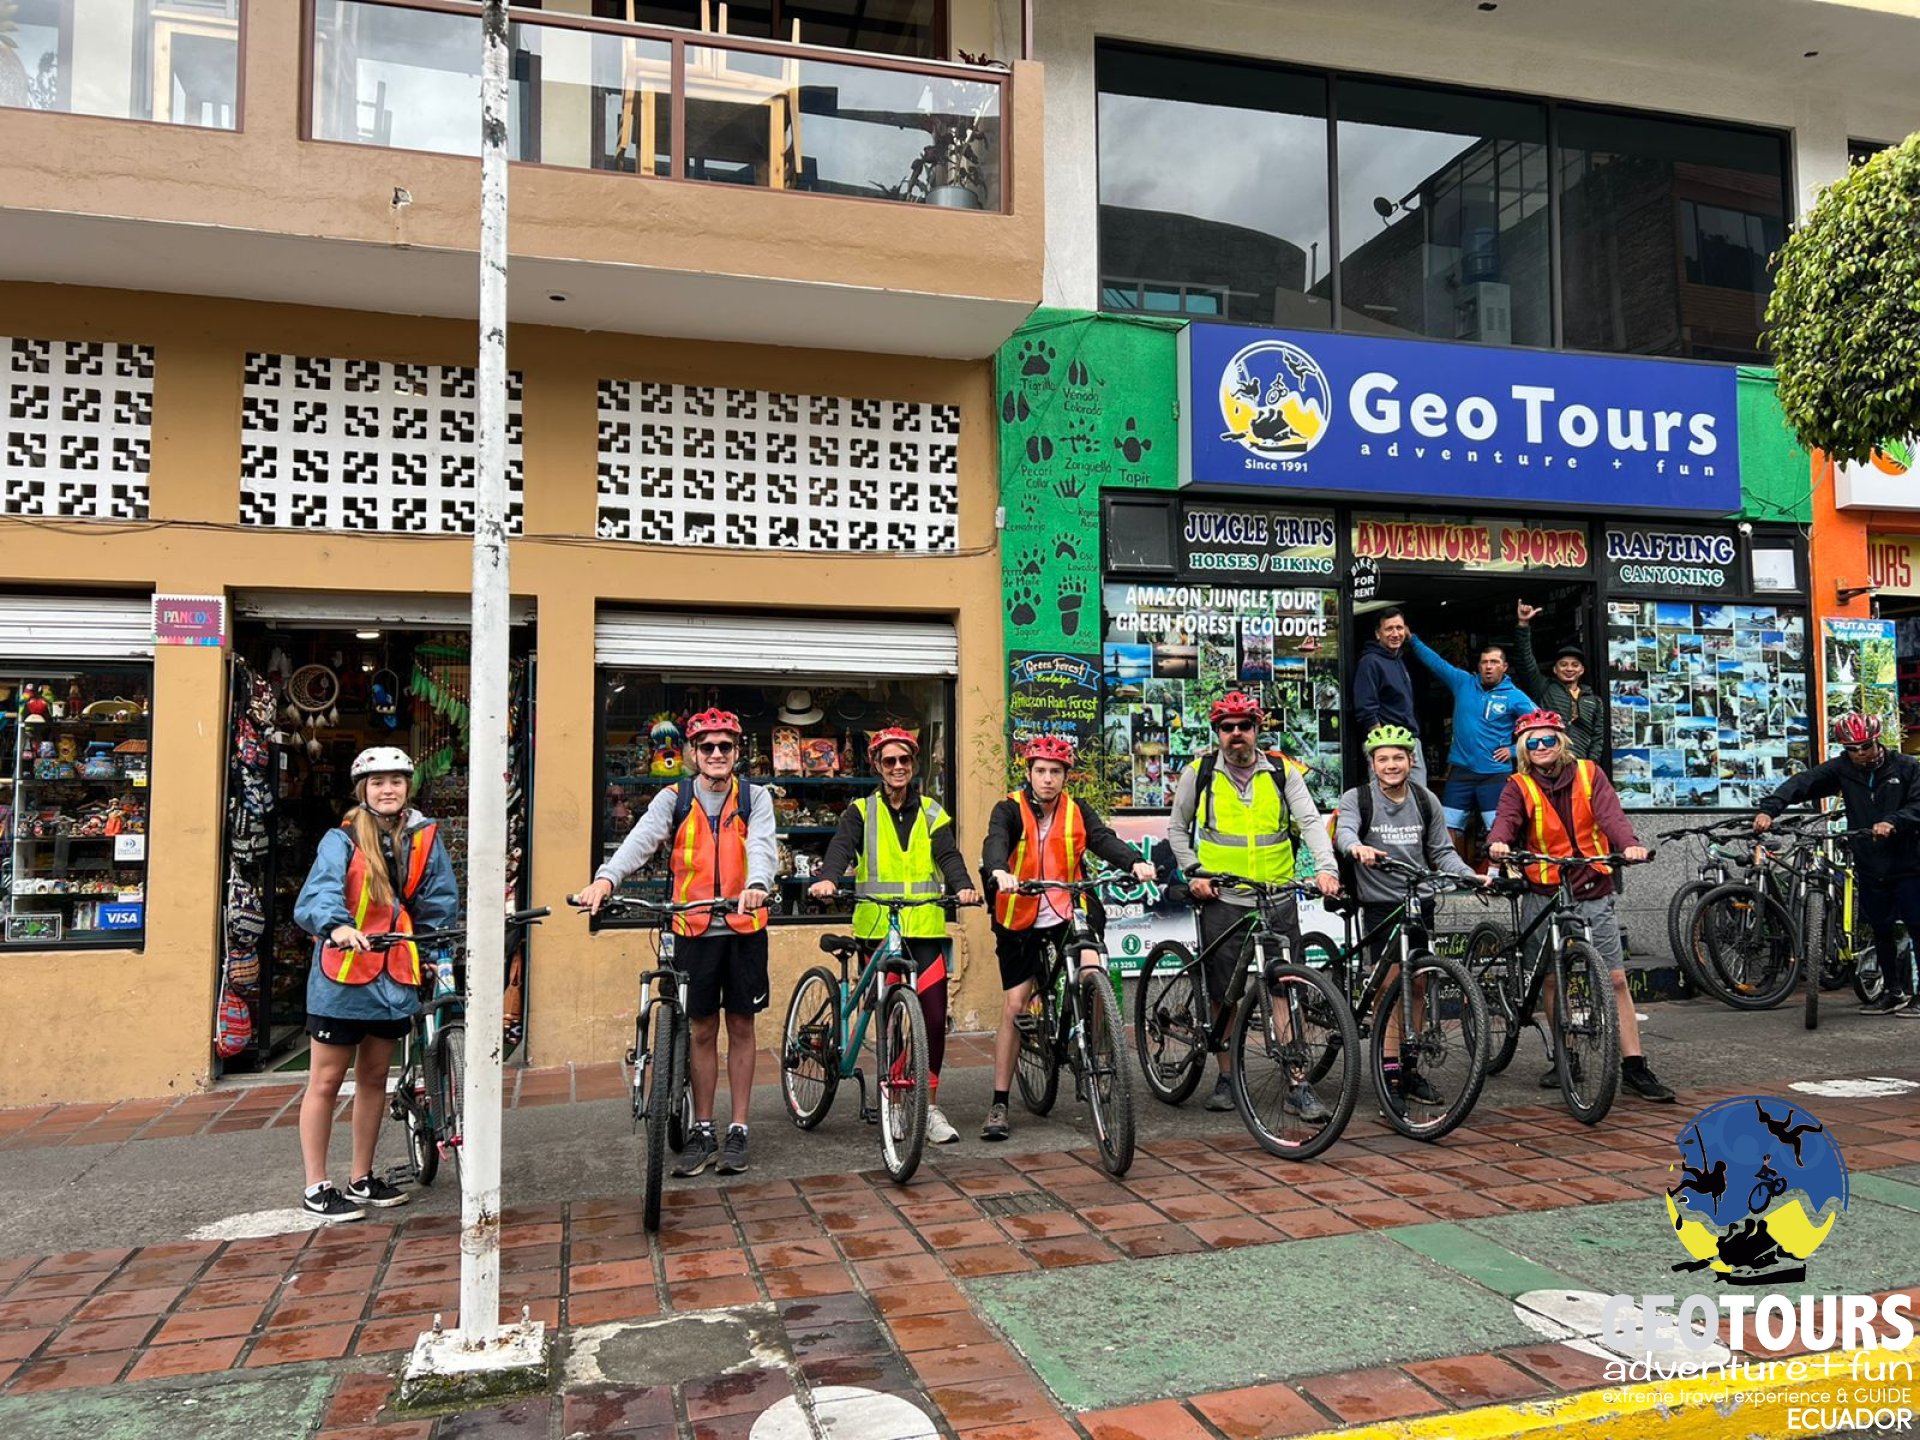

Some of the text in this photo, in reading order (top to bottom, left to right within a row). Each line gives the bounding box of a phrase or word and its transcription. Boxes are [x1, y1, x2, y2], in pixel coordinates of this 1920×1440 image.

[1349, 372, 1717, 456] Geo Tours
[1244, 458, 1309, 473] Since 1991
[1360, 443, 1578, 469] adventure
[1656, 458, 1715, 477] fun
[1118, 468, 1152, 486] Tapir
[1184, 511, 1336, 548] JUNGLE TRIPS
[1352, 520, 1588, 569] ADVENTURE SPORTS
[1607, 530, 1736, 565] RAFTING
[1189, 551, 1258, 573] HORSES
[1270, 555, 1335, 577] BIKING
[1354, 575, 1375, 587] FOR
[1619, 564, 1725, 588] CANYONING
[1125, 587, 1317, 611] AMAZON JUNGLE TOUR
[1354, 586, 1375, 599] RENT
[1116, 612, 1172, 633] GREEN
[1175, 613, 1237, 635] FOREST
[1241, 616, 1328, 638] ECOLODGE
[1833, 621, 1884, 632] RUTA DE
[1025, 657, 1086, 677] Green Forest
[1010, 694, 1098, 711] Amazon Rain Forest
[105, 912, 138, 924] VISA
[1104, 903, 1143, 918] ODGE
